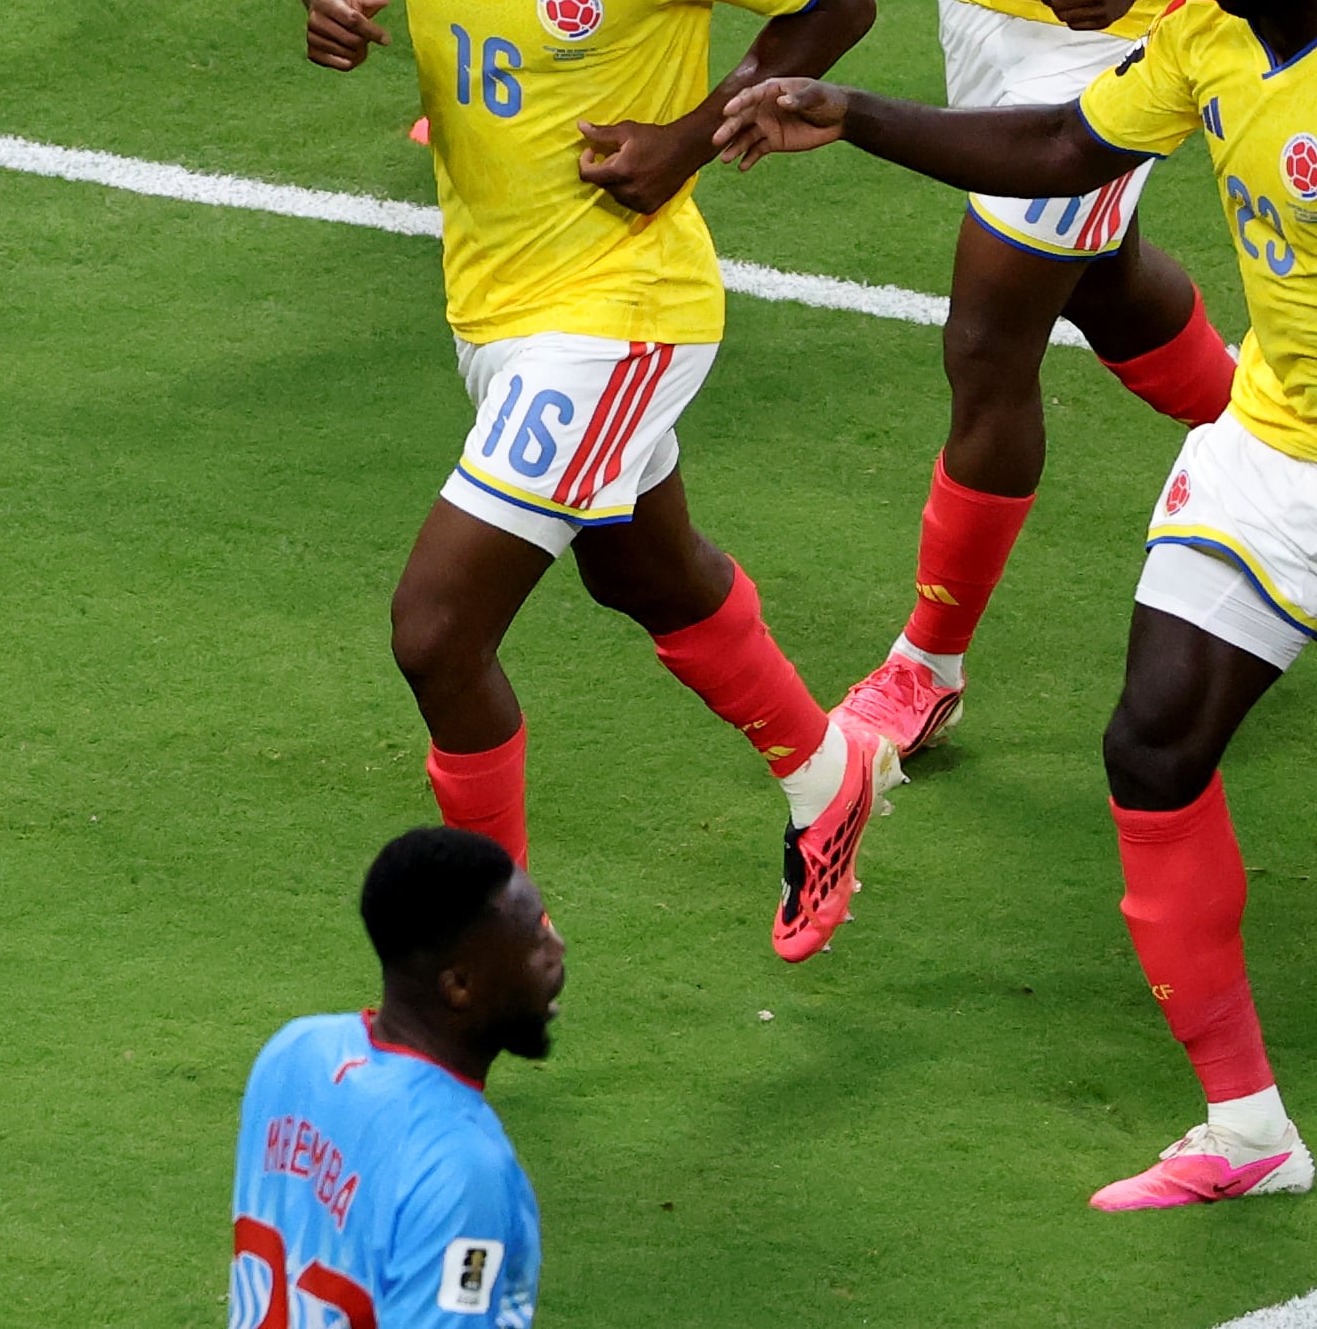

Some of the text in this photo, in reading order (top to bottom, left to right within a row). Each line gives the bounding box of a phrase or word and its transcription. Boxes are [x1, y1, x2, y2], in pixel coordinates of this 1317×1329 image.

[450, 23, 523, 118] 16
[1226, 174, 1296, 277] 23
[481, 374, 576, 479] 16
